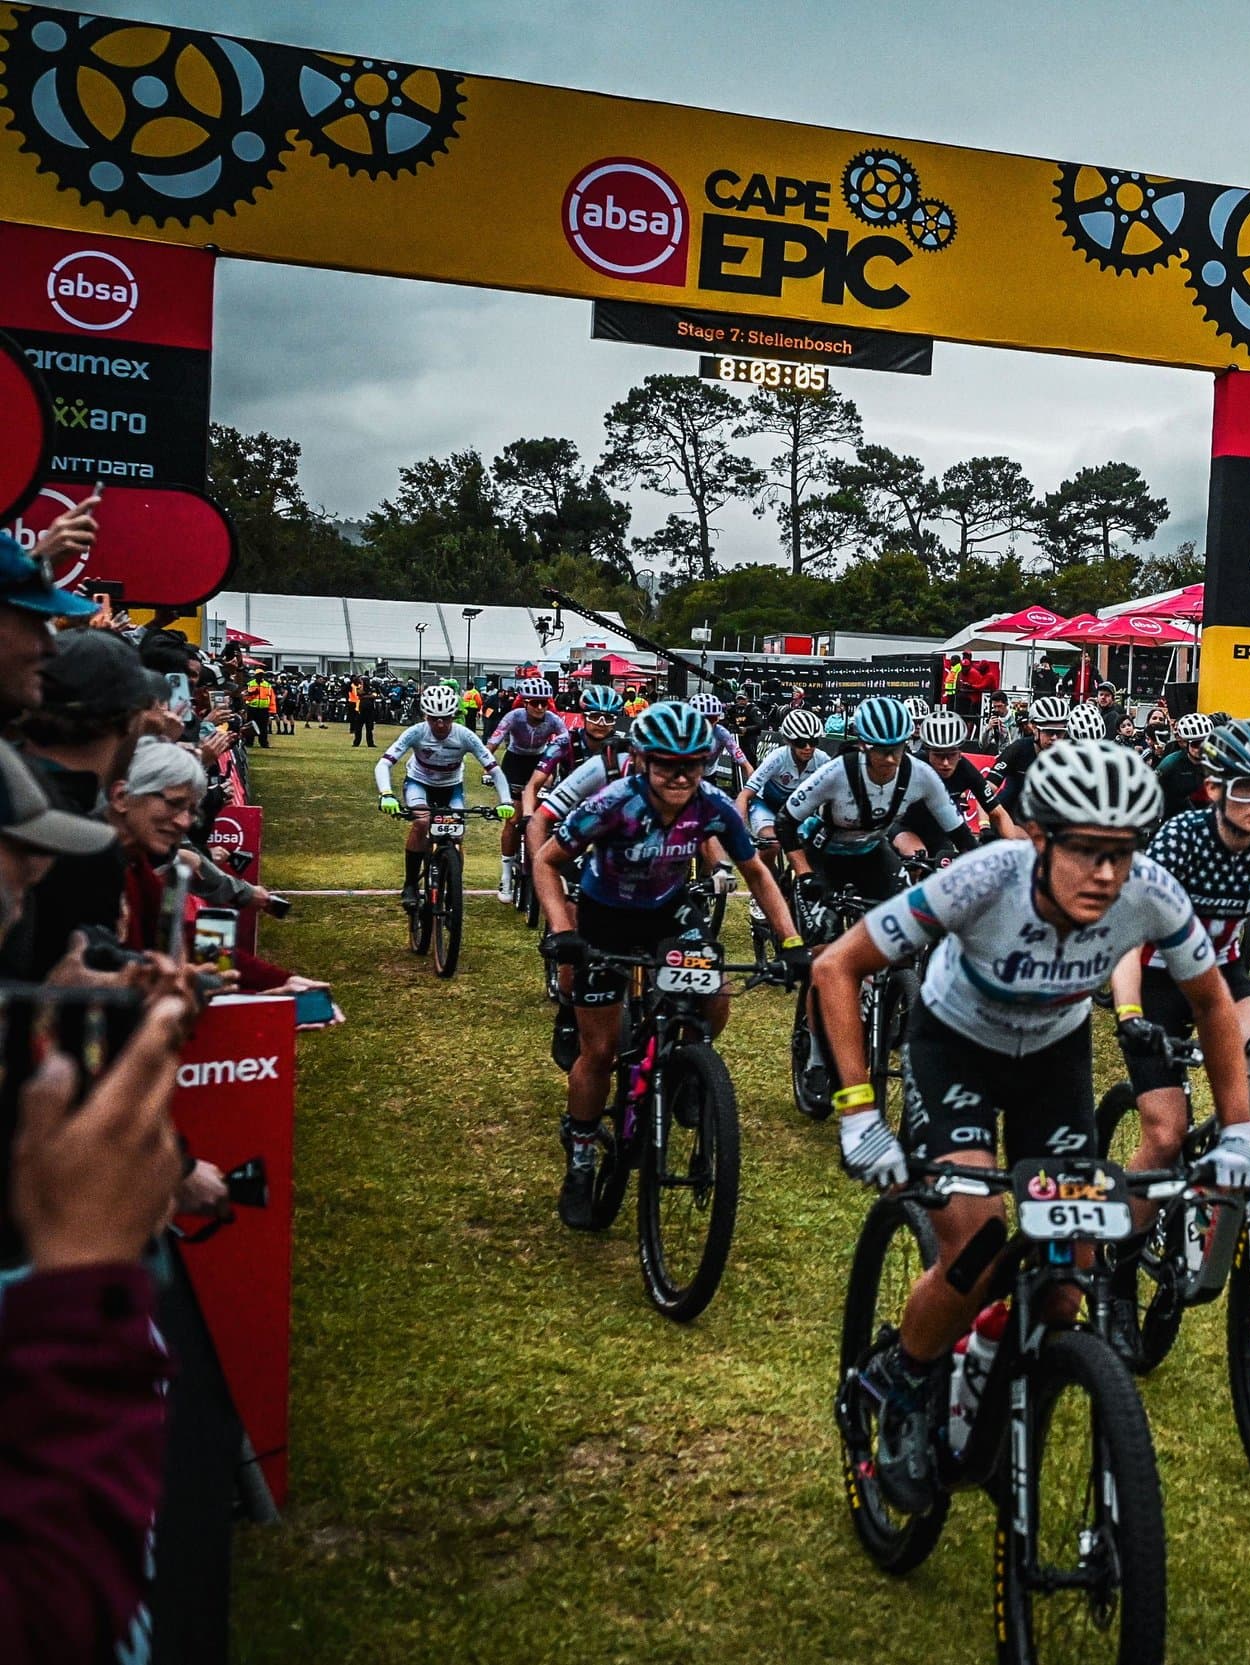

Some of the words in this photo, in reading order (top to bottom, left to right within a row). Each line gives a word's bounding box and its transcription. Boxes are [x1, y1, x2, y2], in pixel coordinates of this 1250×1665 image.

[704, 169, 831, 223] CAPE
[583, 195, 670, 236] absa
[698, 212, 914, 310] EPIC
[58, 273, 129, 303] absa
[677, 321, 725, 343] Stage
[730, 328, 745, 343] 7:
[748, 330, 853, 356] Stellenbosch
[24, 348, 150, 381] aramex
[719, 358, 826, 391] 8:03:05
[52, 397, 147, 435] xxaro
[670, 970, 712, 986] 74-2
[176, 1056, 279, 1087] amex
[1048, 1205, 1106, 1227] 61-1
